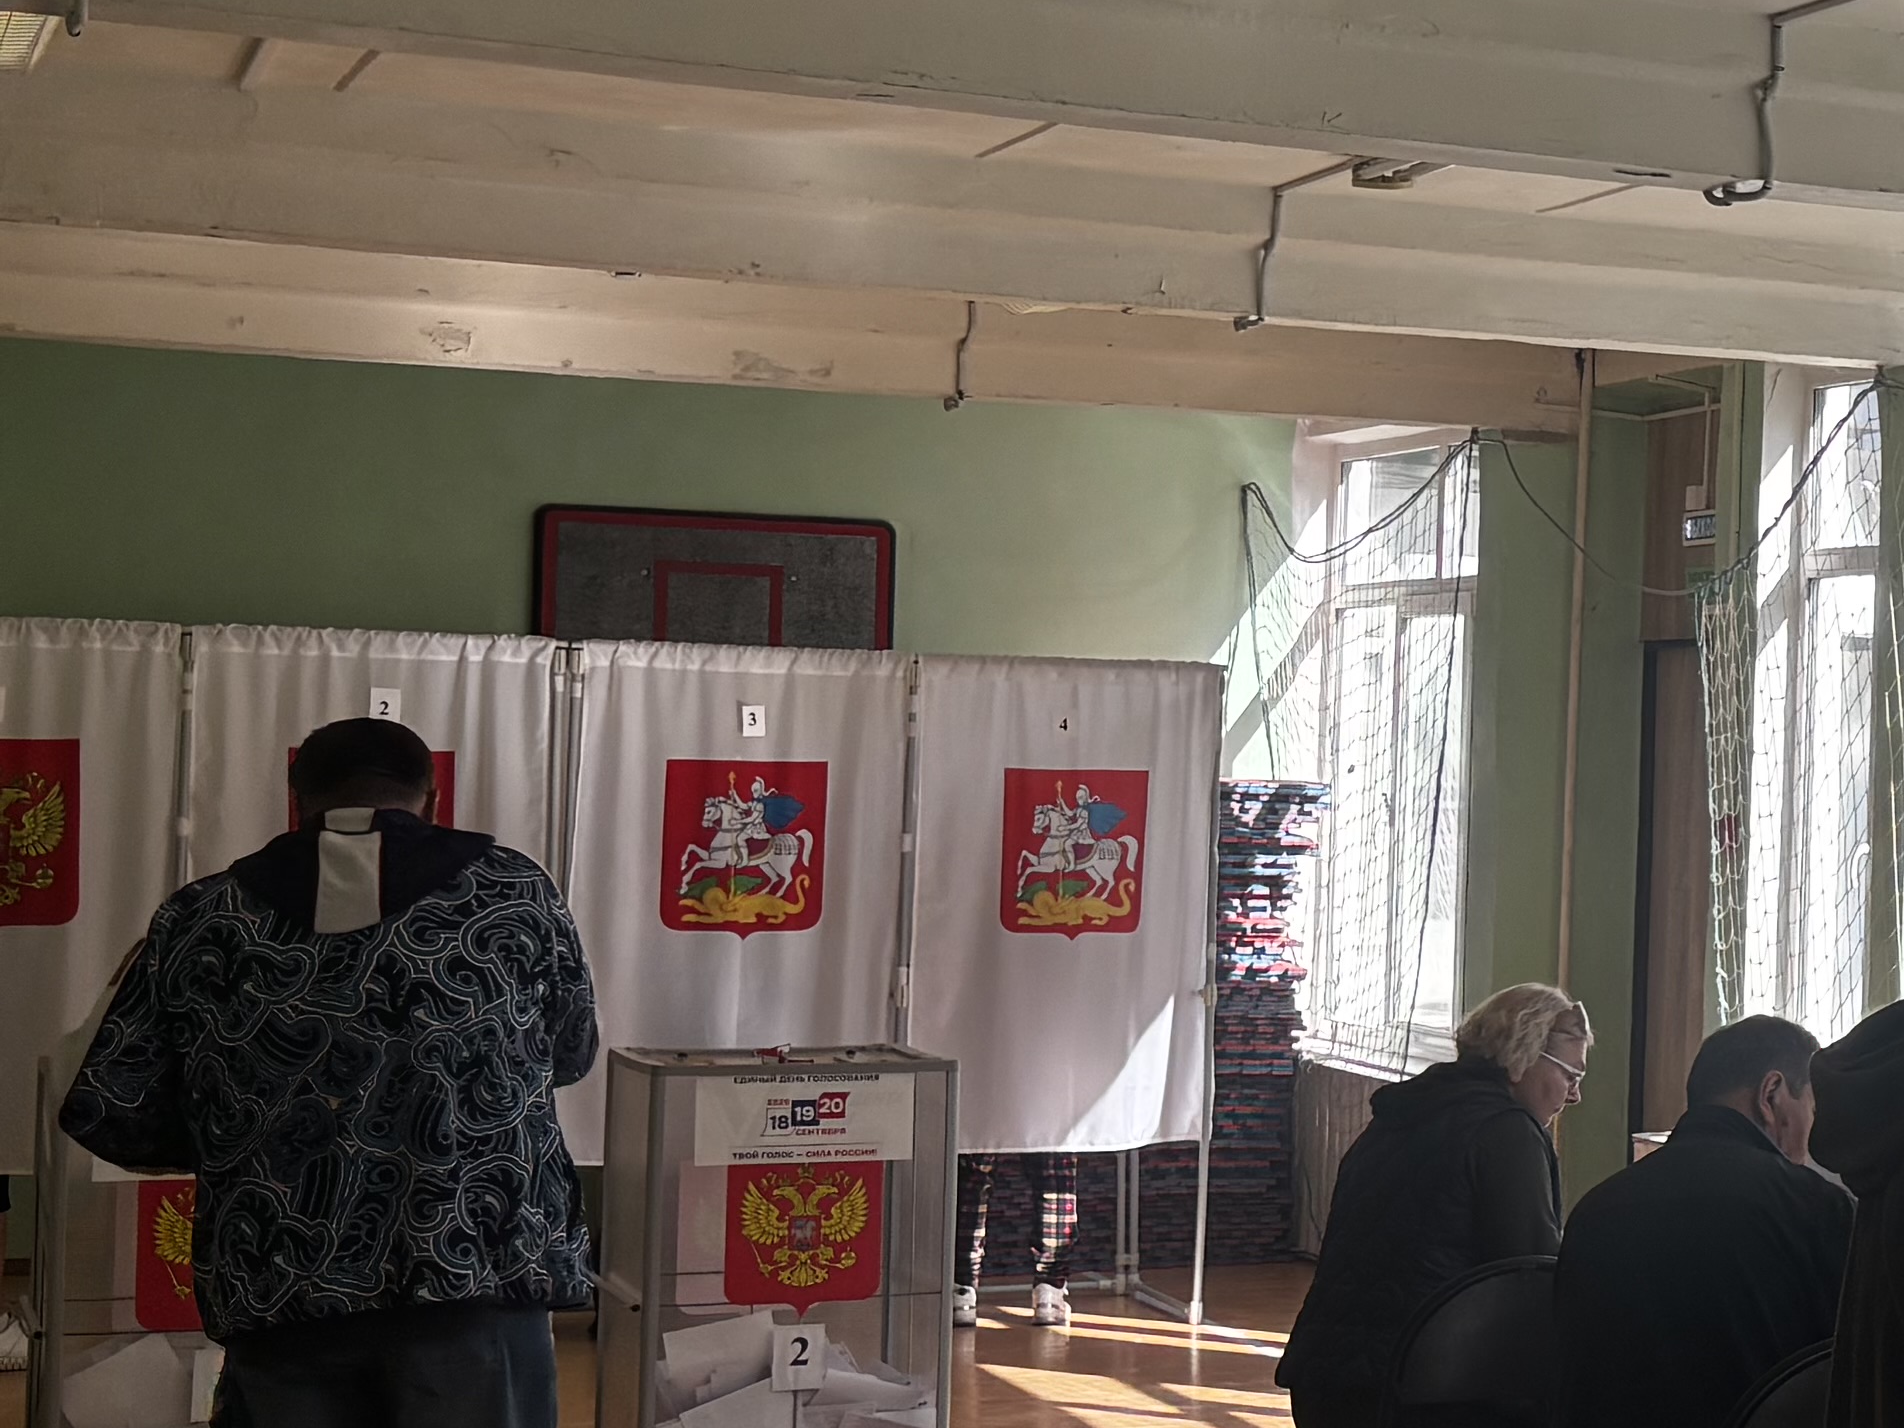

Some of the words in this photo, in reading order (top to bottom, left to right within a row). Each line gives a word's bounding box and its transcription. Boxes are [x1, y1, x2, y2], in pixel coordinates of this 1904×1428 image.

[379, 700, 390, 716] 2
[748, 712, 757, 726] 3
[1059, 717, 1068, 731] 4
[769, 1115, 789, 1130] 18
[794, 1106, 815, 1121] 19
[819, 1098, 844, 1113] 20
[732, 1150, 759, 1160] ТВОЙ
[761, 1151, 794, 1159] ГОЛОС
[805, 1149, 832, 1158] СИЛА
[789, 1336, 809, 1366] 2
